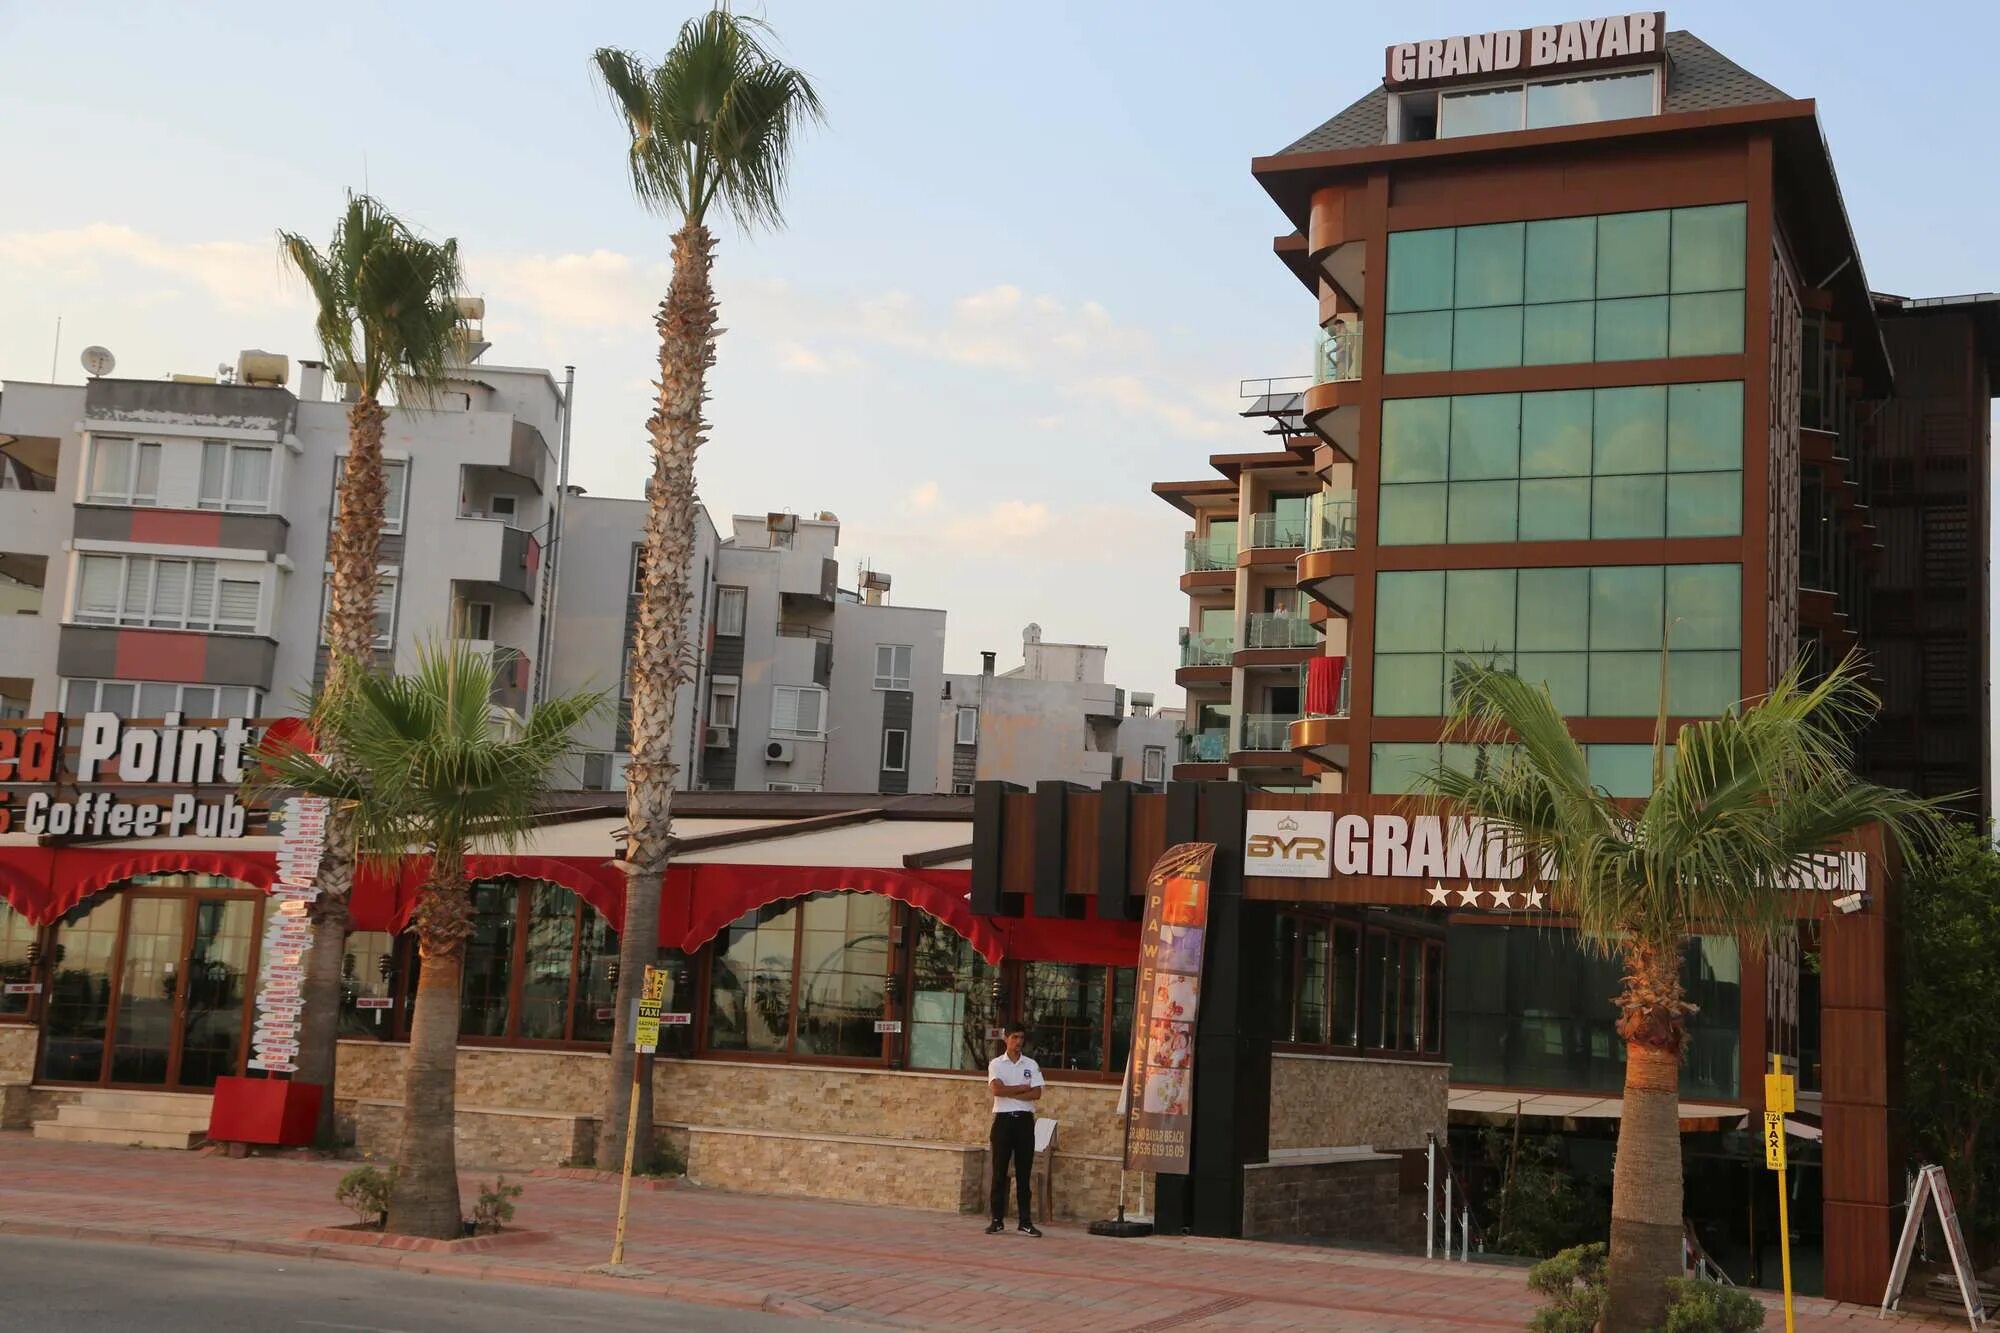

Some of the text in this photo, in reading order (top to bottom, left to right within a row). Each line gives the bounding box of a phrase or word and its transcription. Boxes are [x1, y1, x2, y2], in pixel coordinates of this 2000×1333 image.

[1391, 12, 1656, 82] GRAND BAYAR
[78, 711, 248, 783] Point
[25, 792, 159, 836] Coffee
[169, 794, 245, 838] Pub
[1247, 834, 1326, 861] BYR
[1334, 814, 1524, 879] GRAND
[656, 972, 665, 998] TAXI
[640, 1007, 660, 1017] TAXI
[1766, 1113, 1780, 1121] 7/24
[1769, 1122, 1779, 1157] TAXI
